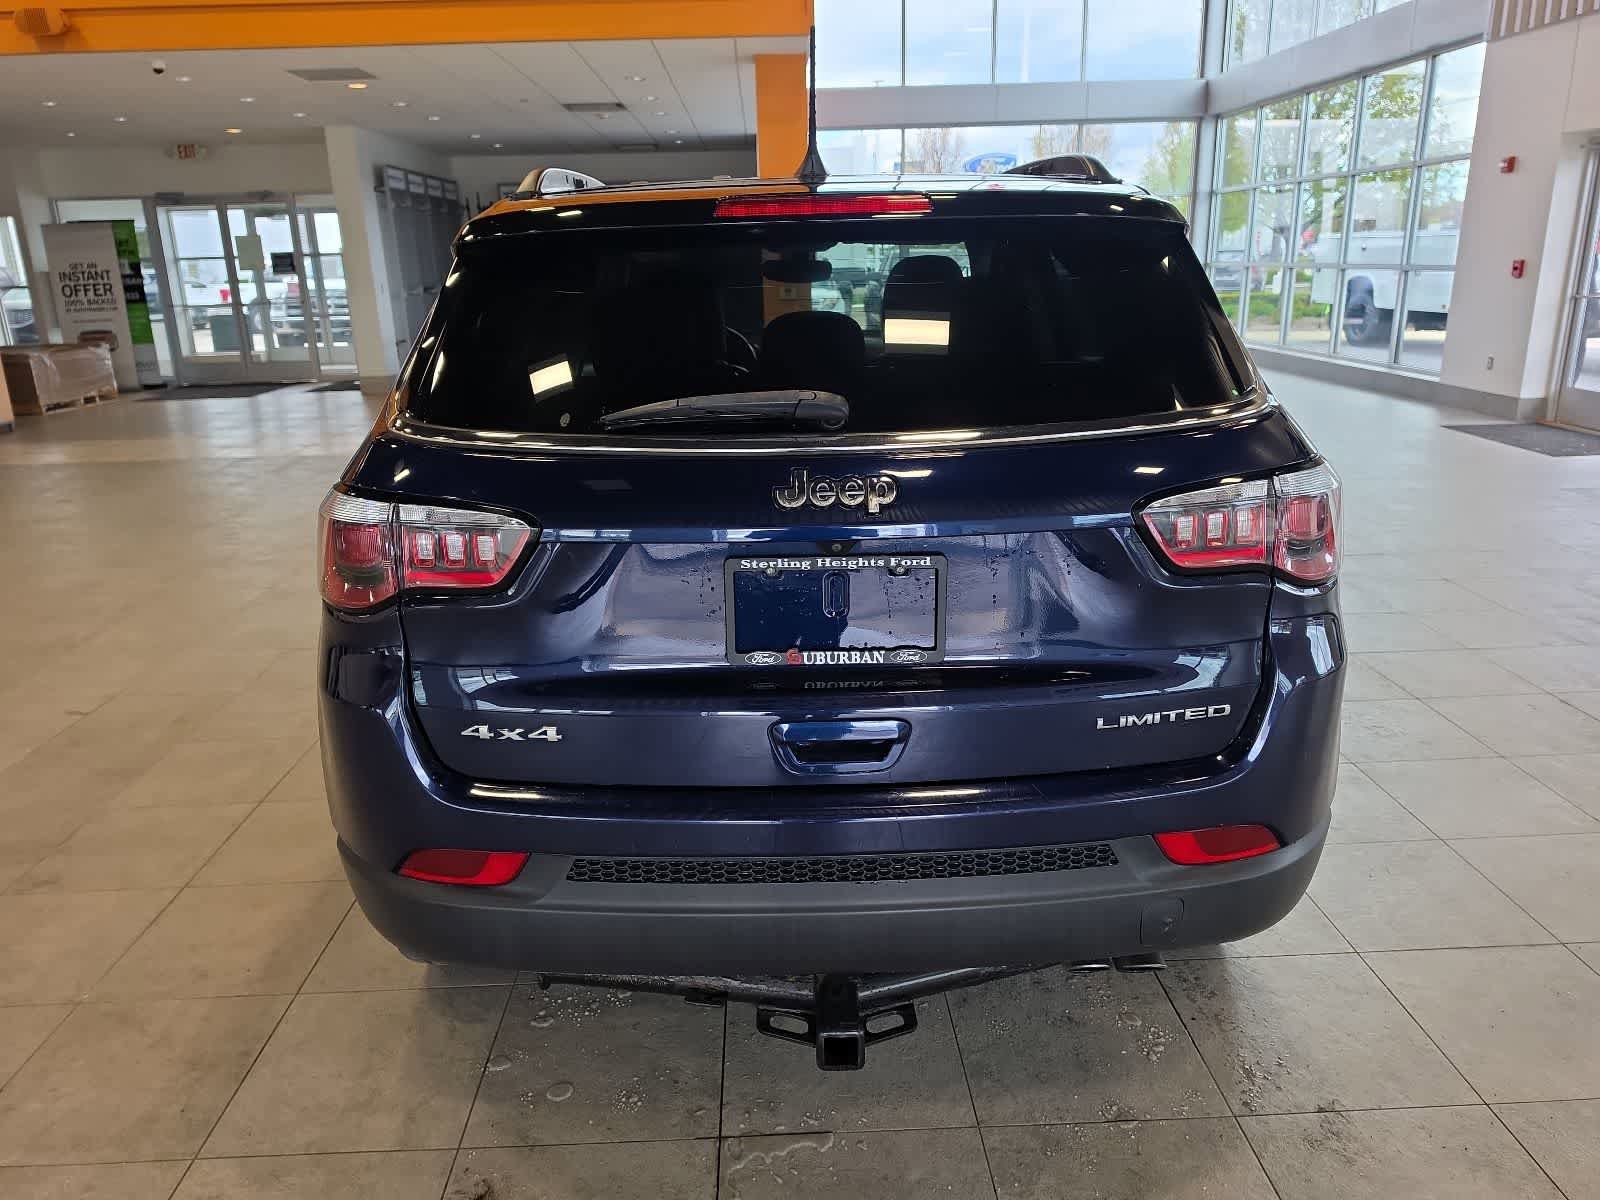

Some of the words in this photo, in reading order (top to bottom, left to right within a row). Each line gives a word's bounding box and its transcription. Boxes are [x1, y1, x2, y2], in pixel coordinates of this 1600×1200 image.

[177, 144, 198, 159] EXIT
[59, 270, 110, 282] INSTANT
[61, 283, 113, 298] OFFER
[773, 467, 898, 514] Jeep
[741, 559, 811, 570] Sterling
[816, 558, 885, 569] Heights
[890, 557, 931, 567] Ford
[786, 648, 885, 665] SUBURBAN
[1096, 704, 1231, 730] LIMITED
[461, 724, 562, 742] 4x4
